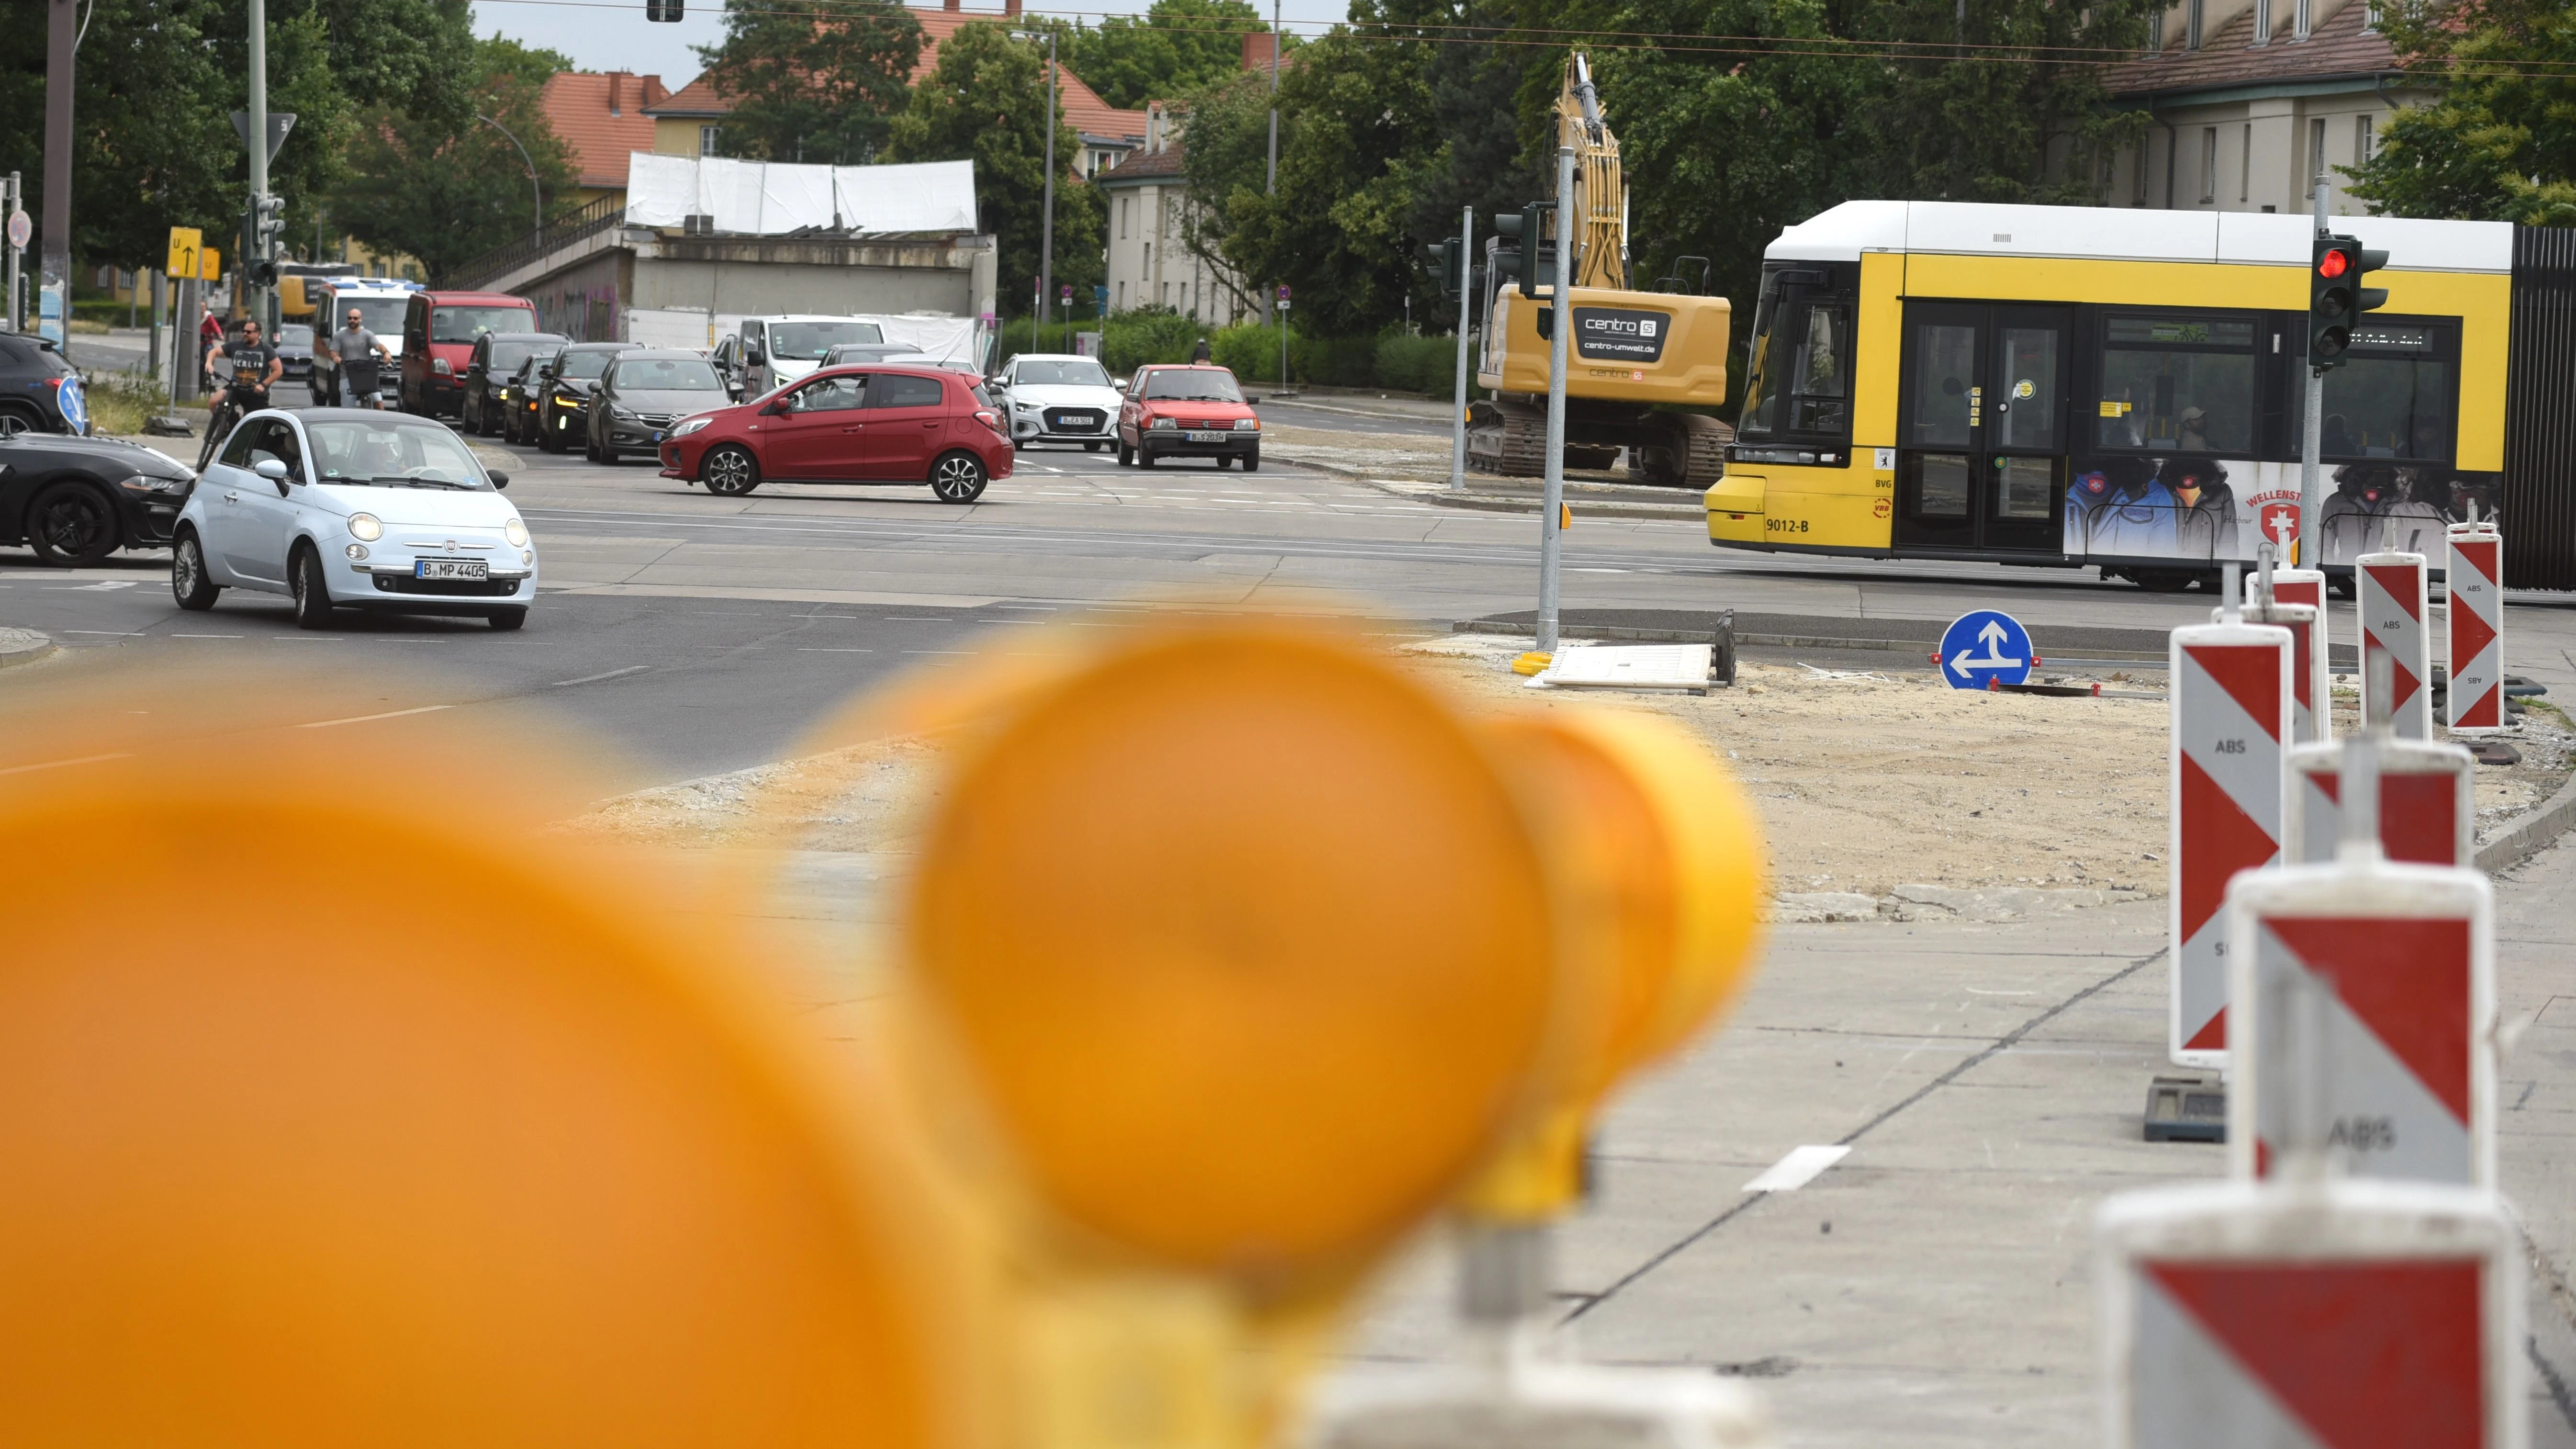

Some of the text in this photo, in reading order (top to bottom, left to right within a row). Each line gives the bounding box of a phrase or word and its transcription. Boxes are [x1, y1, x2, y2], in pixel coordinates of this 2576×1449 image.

[173, 238, 180, 248] U
[1586, 318, 1636, 331] centro
[1584, 342, 1655, 353] centro-umwelt.de
[1589, 368, 1629, 378] centro
[1876, 480, 1892, 488] BVG
[1767, 519, 1809, 532] 9012-B
[424, 563, 431, 575] B
[439, 564, 454, 576] MP
[457, 565, 485, 577] 4405
[2383, 621, 2400, 629] ABS
[2215, 739, 2246, 754] ABS
